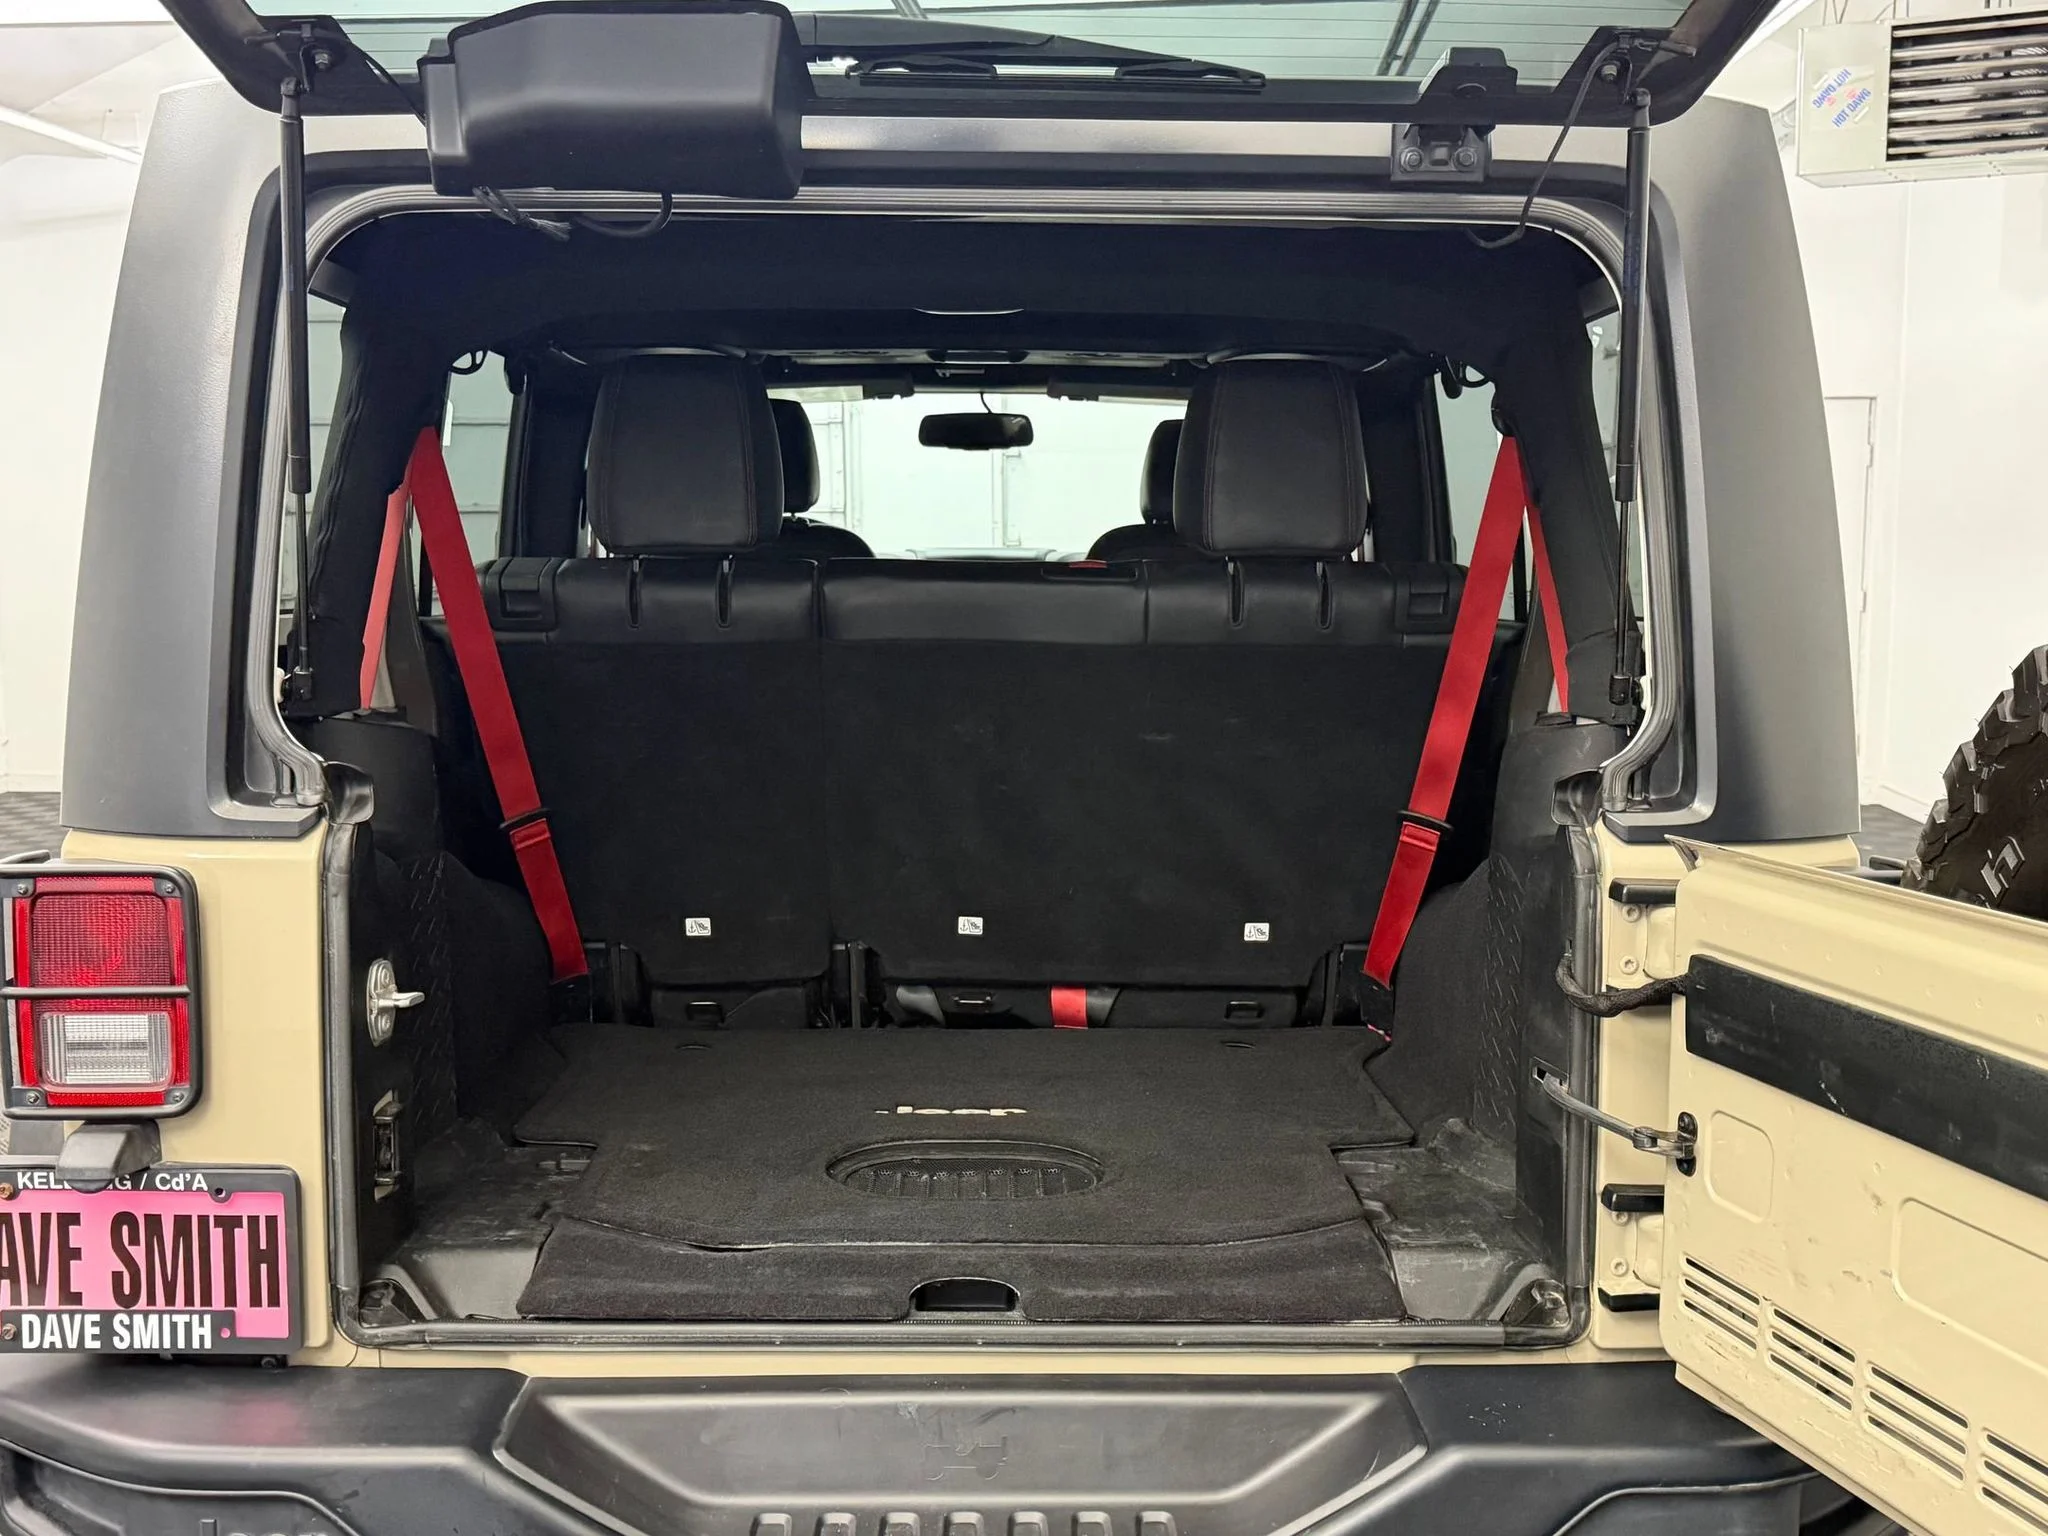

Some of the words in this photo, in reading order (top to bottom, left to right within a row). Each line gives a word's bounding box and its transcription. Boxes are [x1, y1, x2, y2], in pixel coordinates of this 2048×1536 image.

[1831, 109, 1850, 128] HOT
[17, 1171, 132, 1190] KELG
[110, 1211, 281, 1309] SMITH
[21, 1313, 101, 1350] DAVE
[113, 1313, 212, 1350] SMITH
